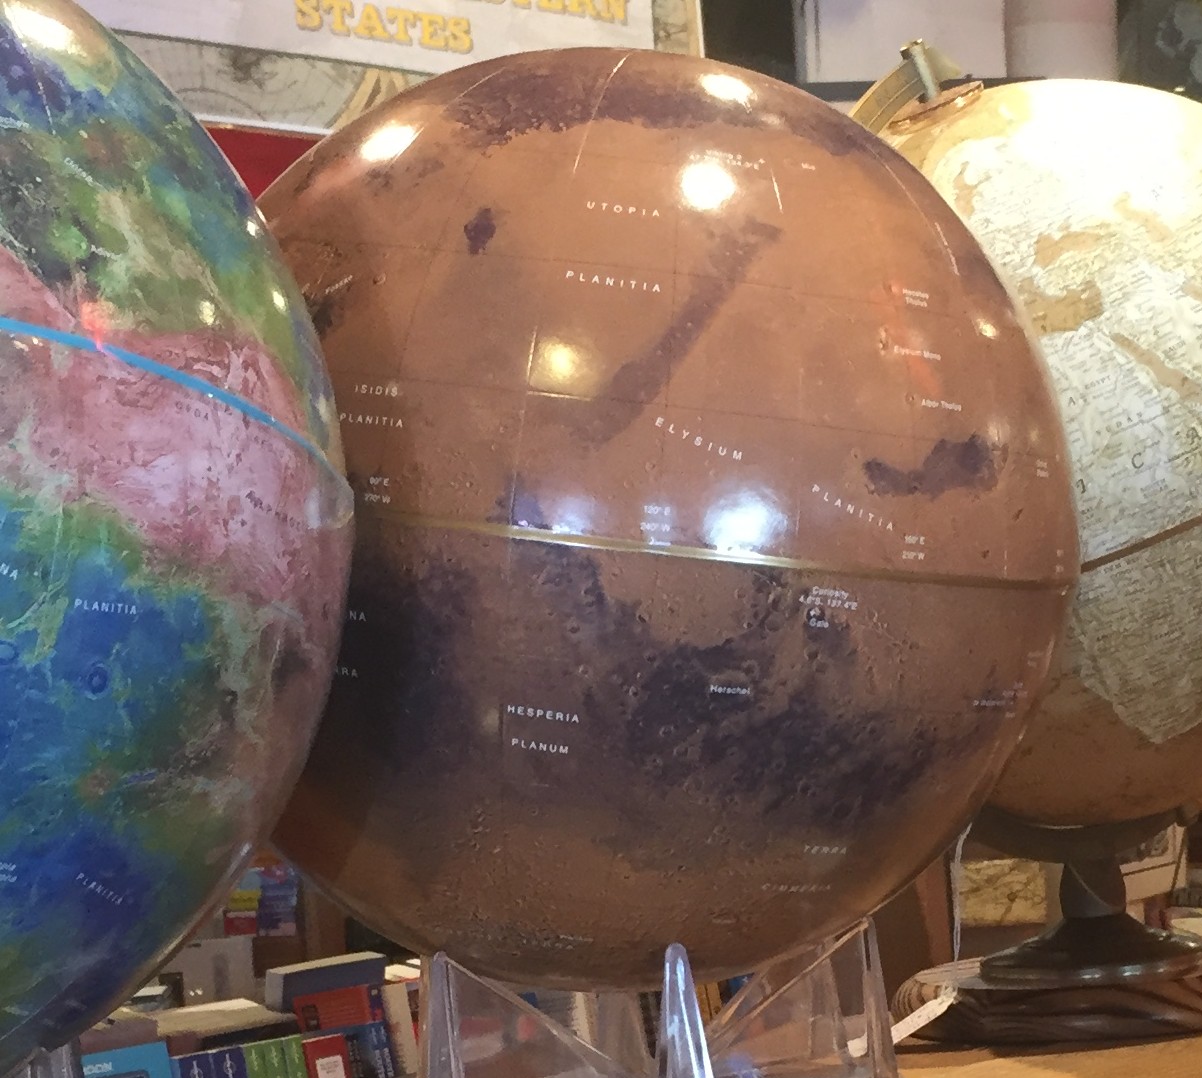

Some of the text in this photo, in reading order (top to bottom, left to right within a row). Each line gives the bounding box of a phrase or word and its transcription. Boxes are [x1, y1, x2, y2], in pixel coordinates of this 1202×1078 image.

[295, 0, 474, 55] STATES
[586, 201, 660, 217] UTOPIA
[565, 270, 661, 293] PLANITIA
[354, 384, 398, 397] ISIDIS
[339, 413, 404, 428] PLANITIA
[655, 416, 743, 461] ELYSIUM
[811, 483, 894, 531] PLANITIA
[812, 585, 849, 600] Curiosity
[74, 598, 138, 615] PLANITIA
[709, 683, 751, 696] Herschel
[507, 704, 580, 724] HESPERIA
[511, 738, 569, 755] PLANUM
[76, 872, 125, 905] PLANITIA
